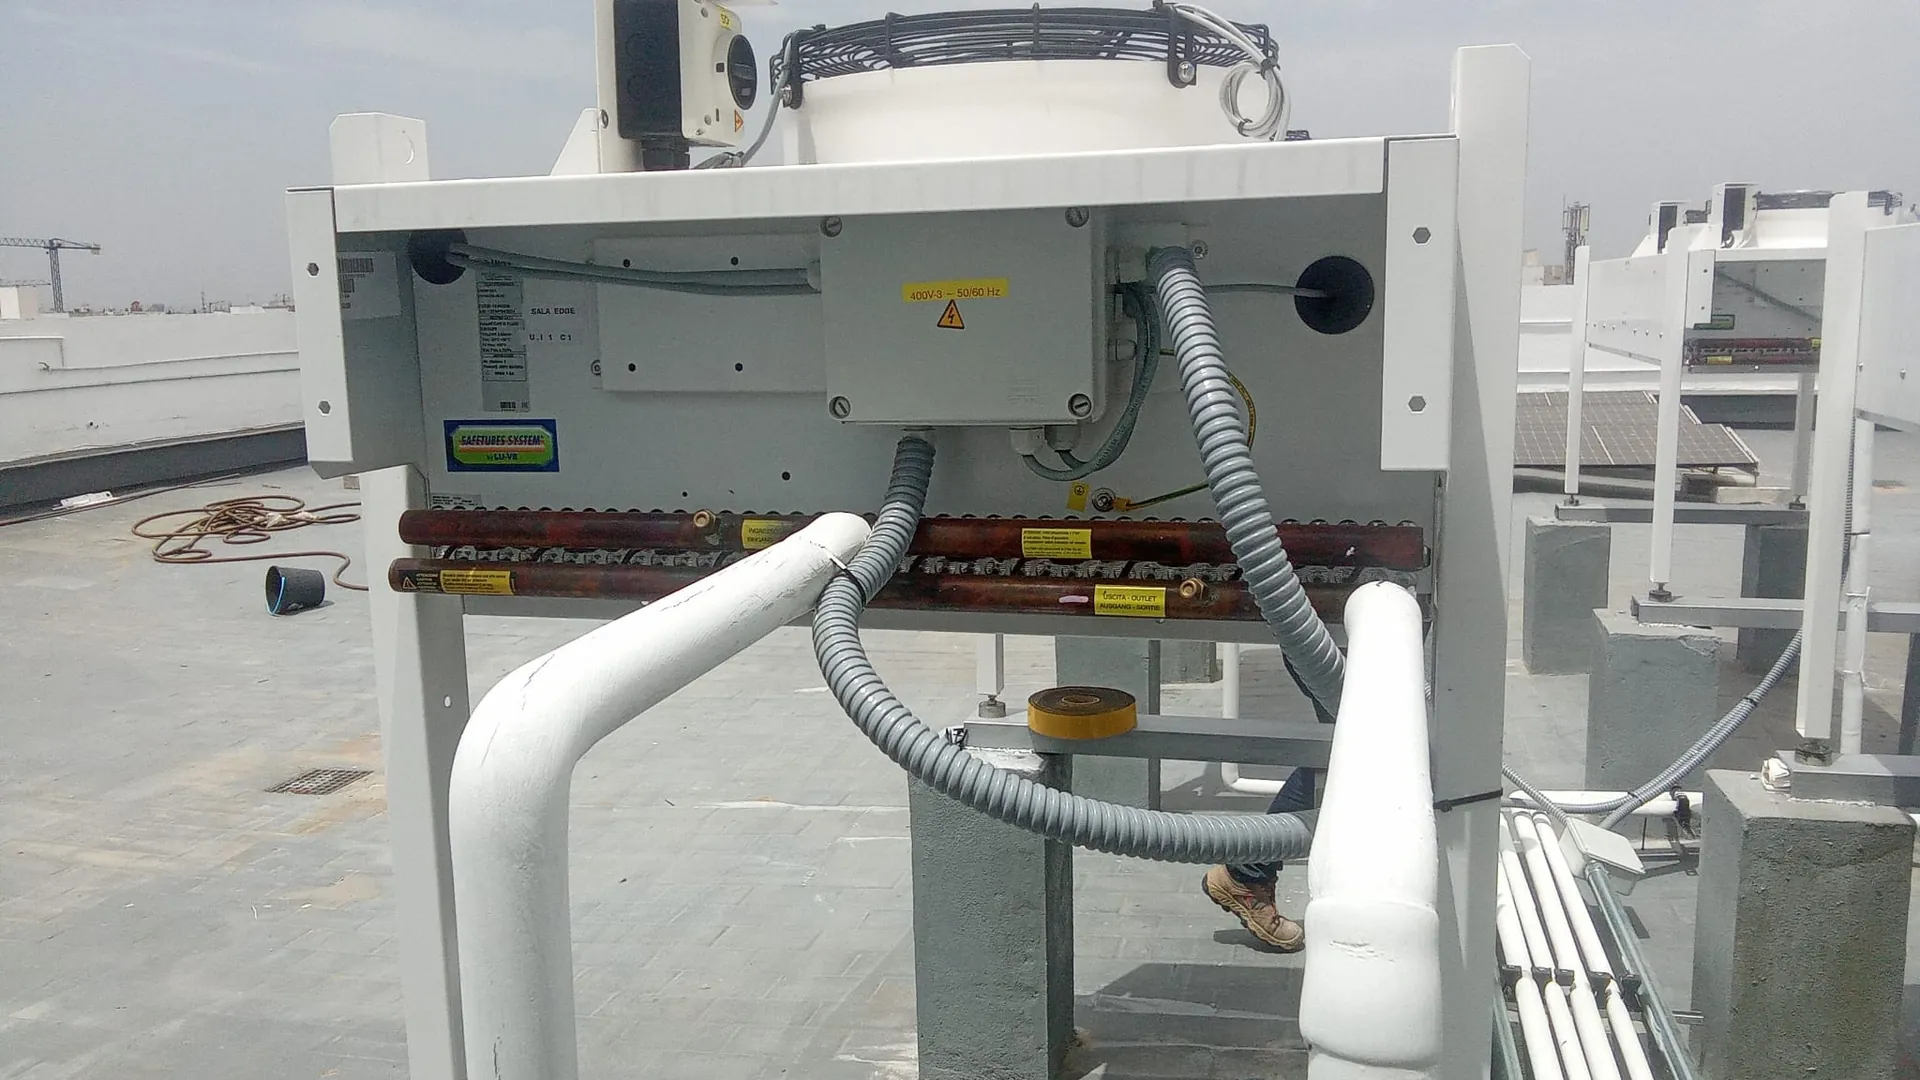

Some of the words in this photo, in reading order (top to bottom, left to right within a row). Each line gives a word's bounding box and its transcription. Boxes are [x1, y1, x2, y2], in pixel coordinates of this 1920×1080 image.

[910, 289, 943, 301] 400V-3
[957, 287, 984, 298] 50/60
[987, 286, 1002, 297] Hz
[530, 307, 551, 315] SALA
[1131, 594, 1157, 602] OUTLET
